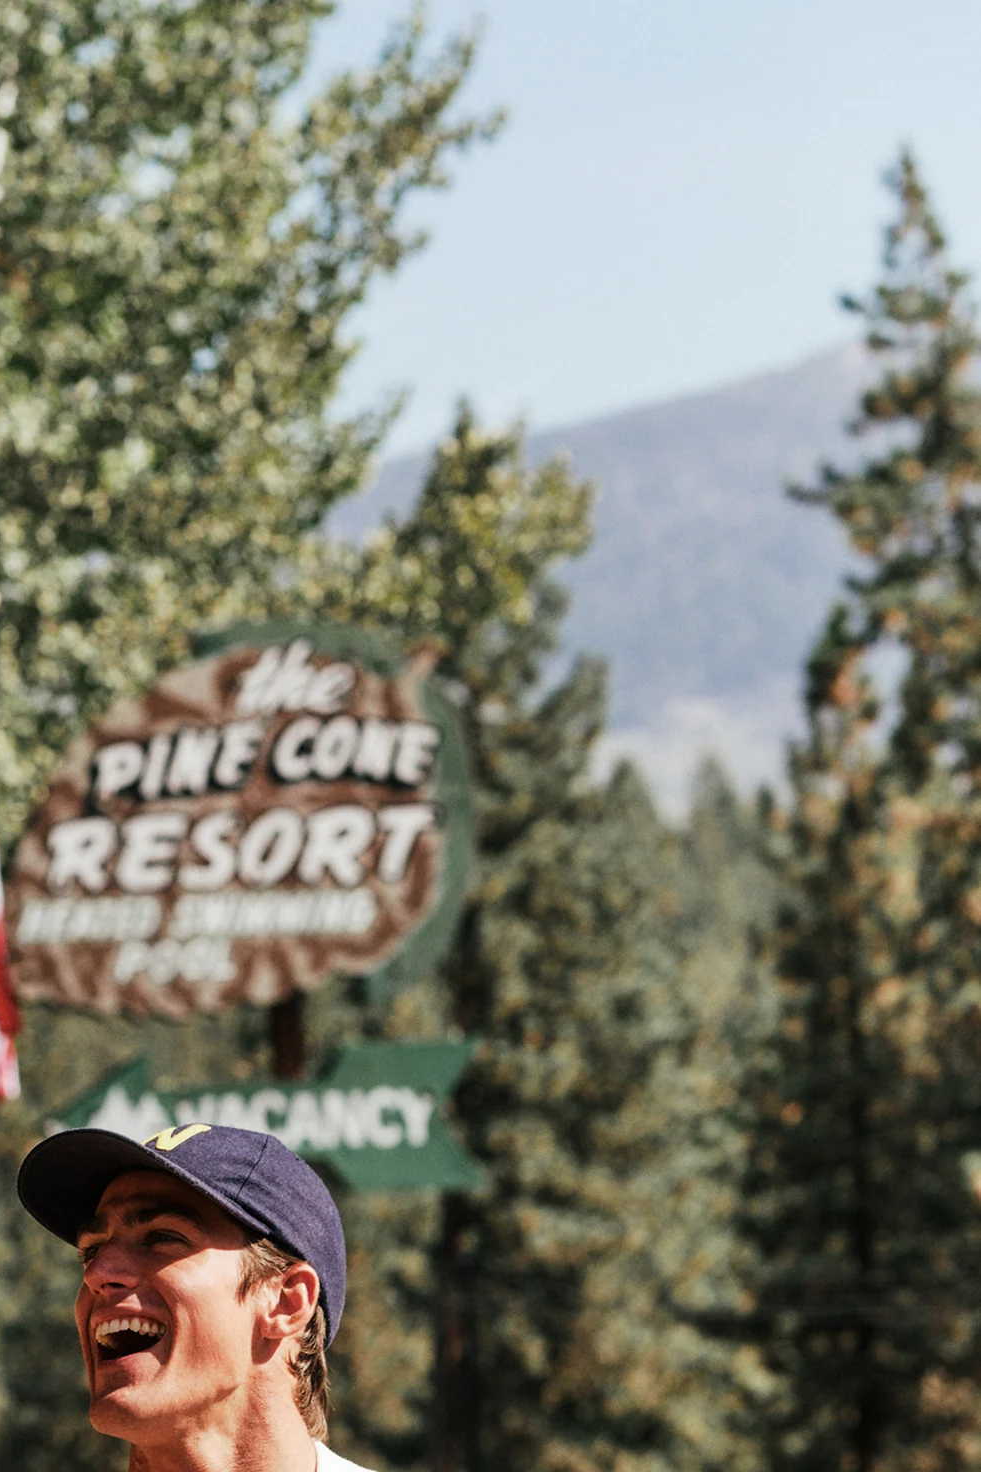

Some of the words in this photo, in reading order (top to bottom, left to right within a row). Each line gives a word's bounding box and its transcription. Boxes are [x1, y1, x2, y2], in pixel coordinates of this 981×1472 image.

[236, 638, 356, 715] the
[94, 720, 265, 800] PINE
[271, 715, 442, 786] CONE
[47, 803, 435, 893] RESORT
